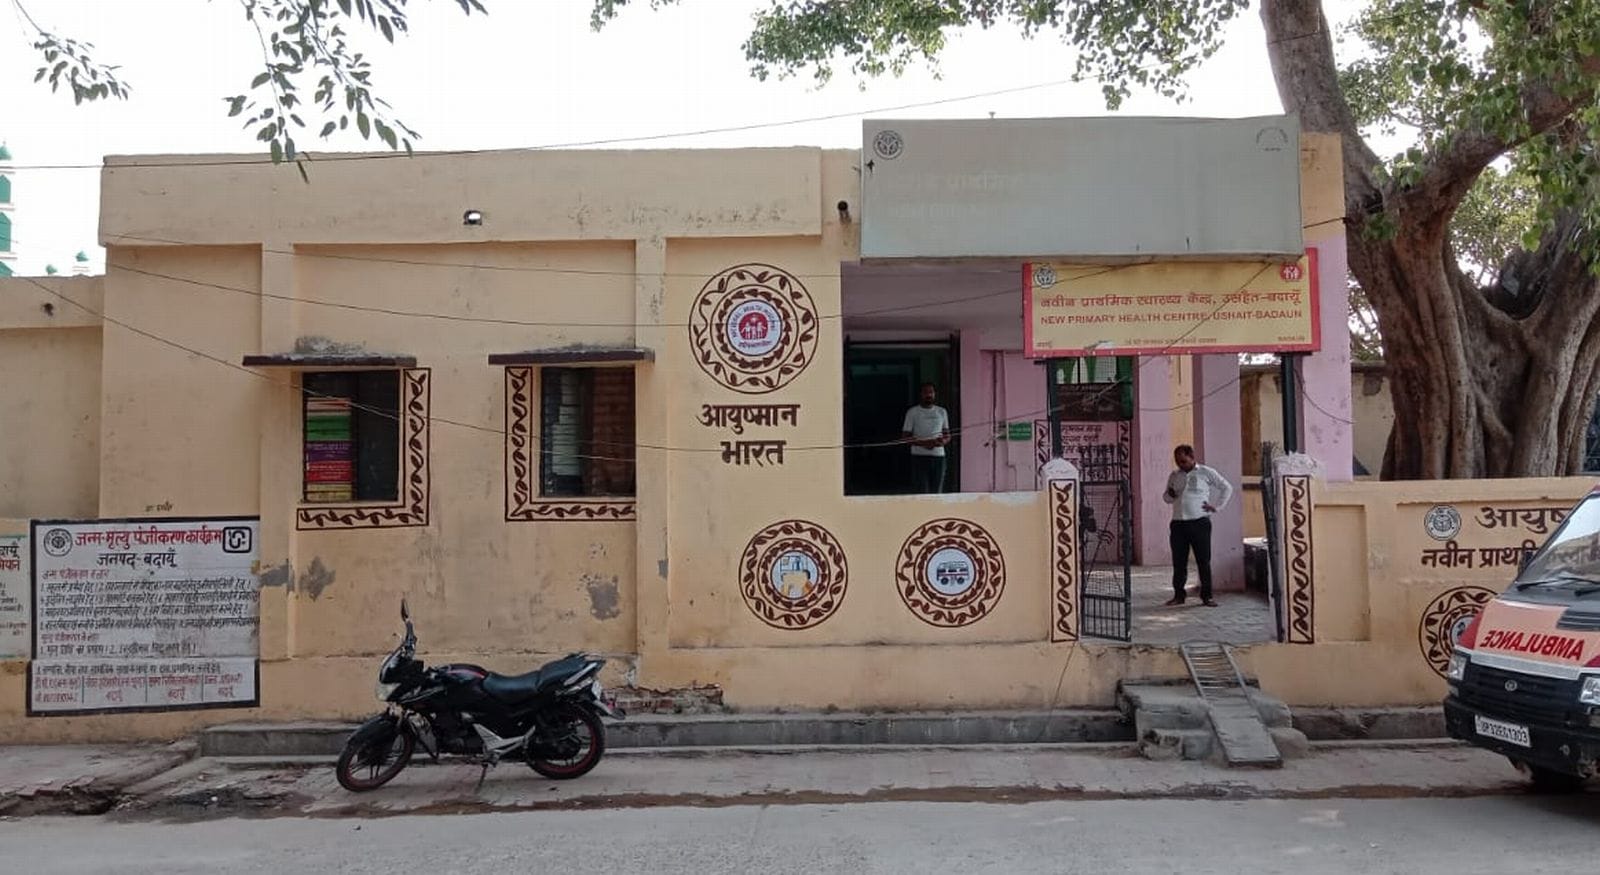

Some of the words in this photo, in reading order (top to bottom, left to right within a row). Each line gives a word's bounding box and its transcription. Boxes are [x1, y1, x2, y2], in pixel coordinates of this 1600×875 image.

[1040, 315, 1066, 325] NEW
[1068, 313, 1117, 324] PRIMARY
[1119, 312, 1161, 323] HEALTH
[696, 404, 801, 435] आयुष्मान
[720, 440, 787, 467] भारत
[1421, 540, 1475, 569] नवीन
